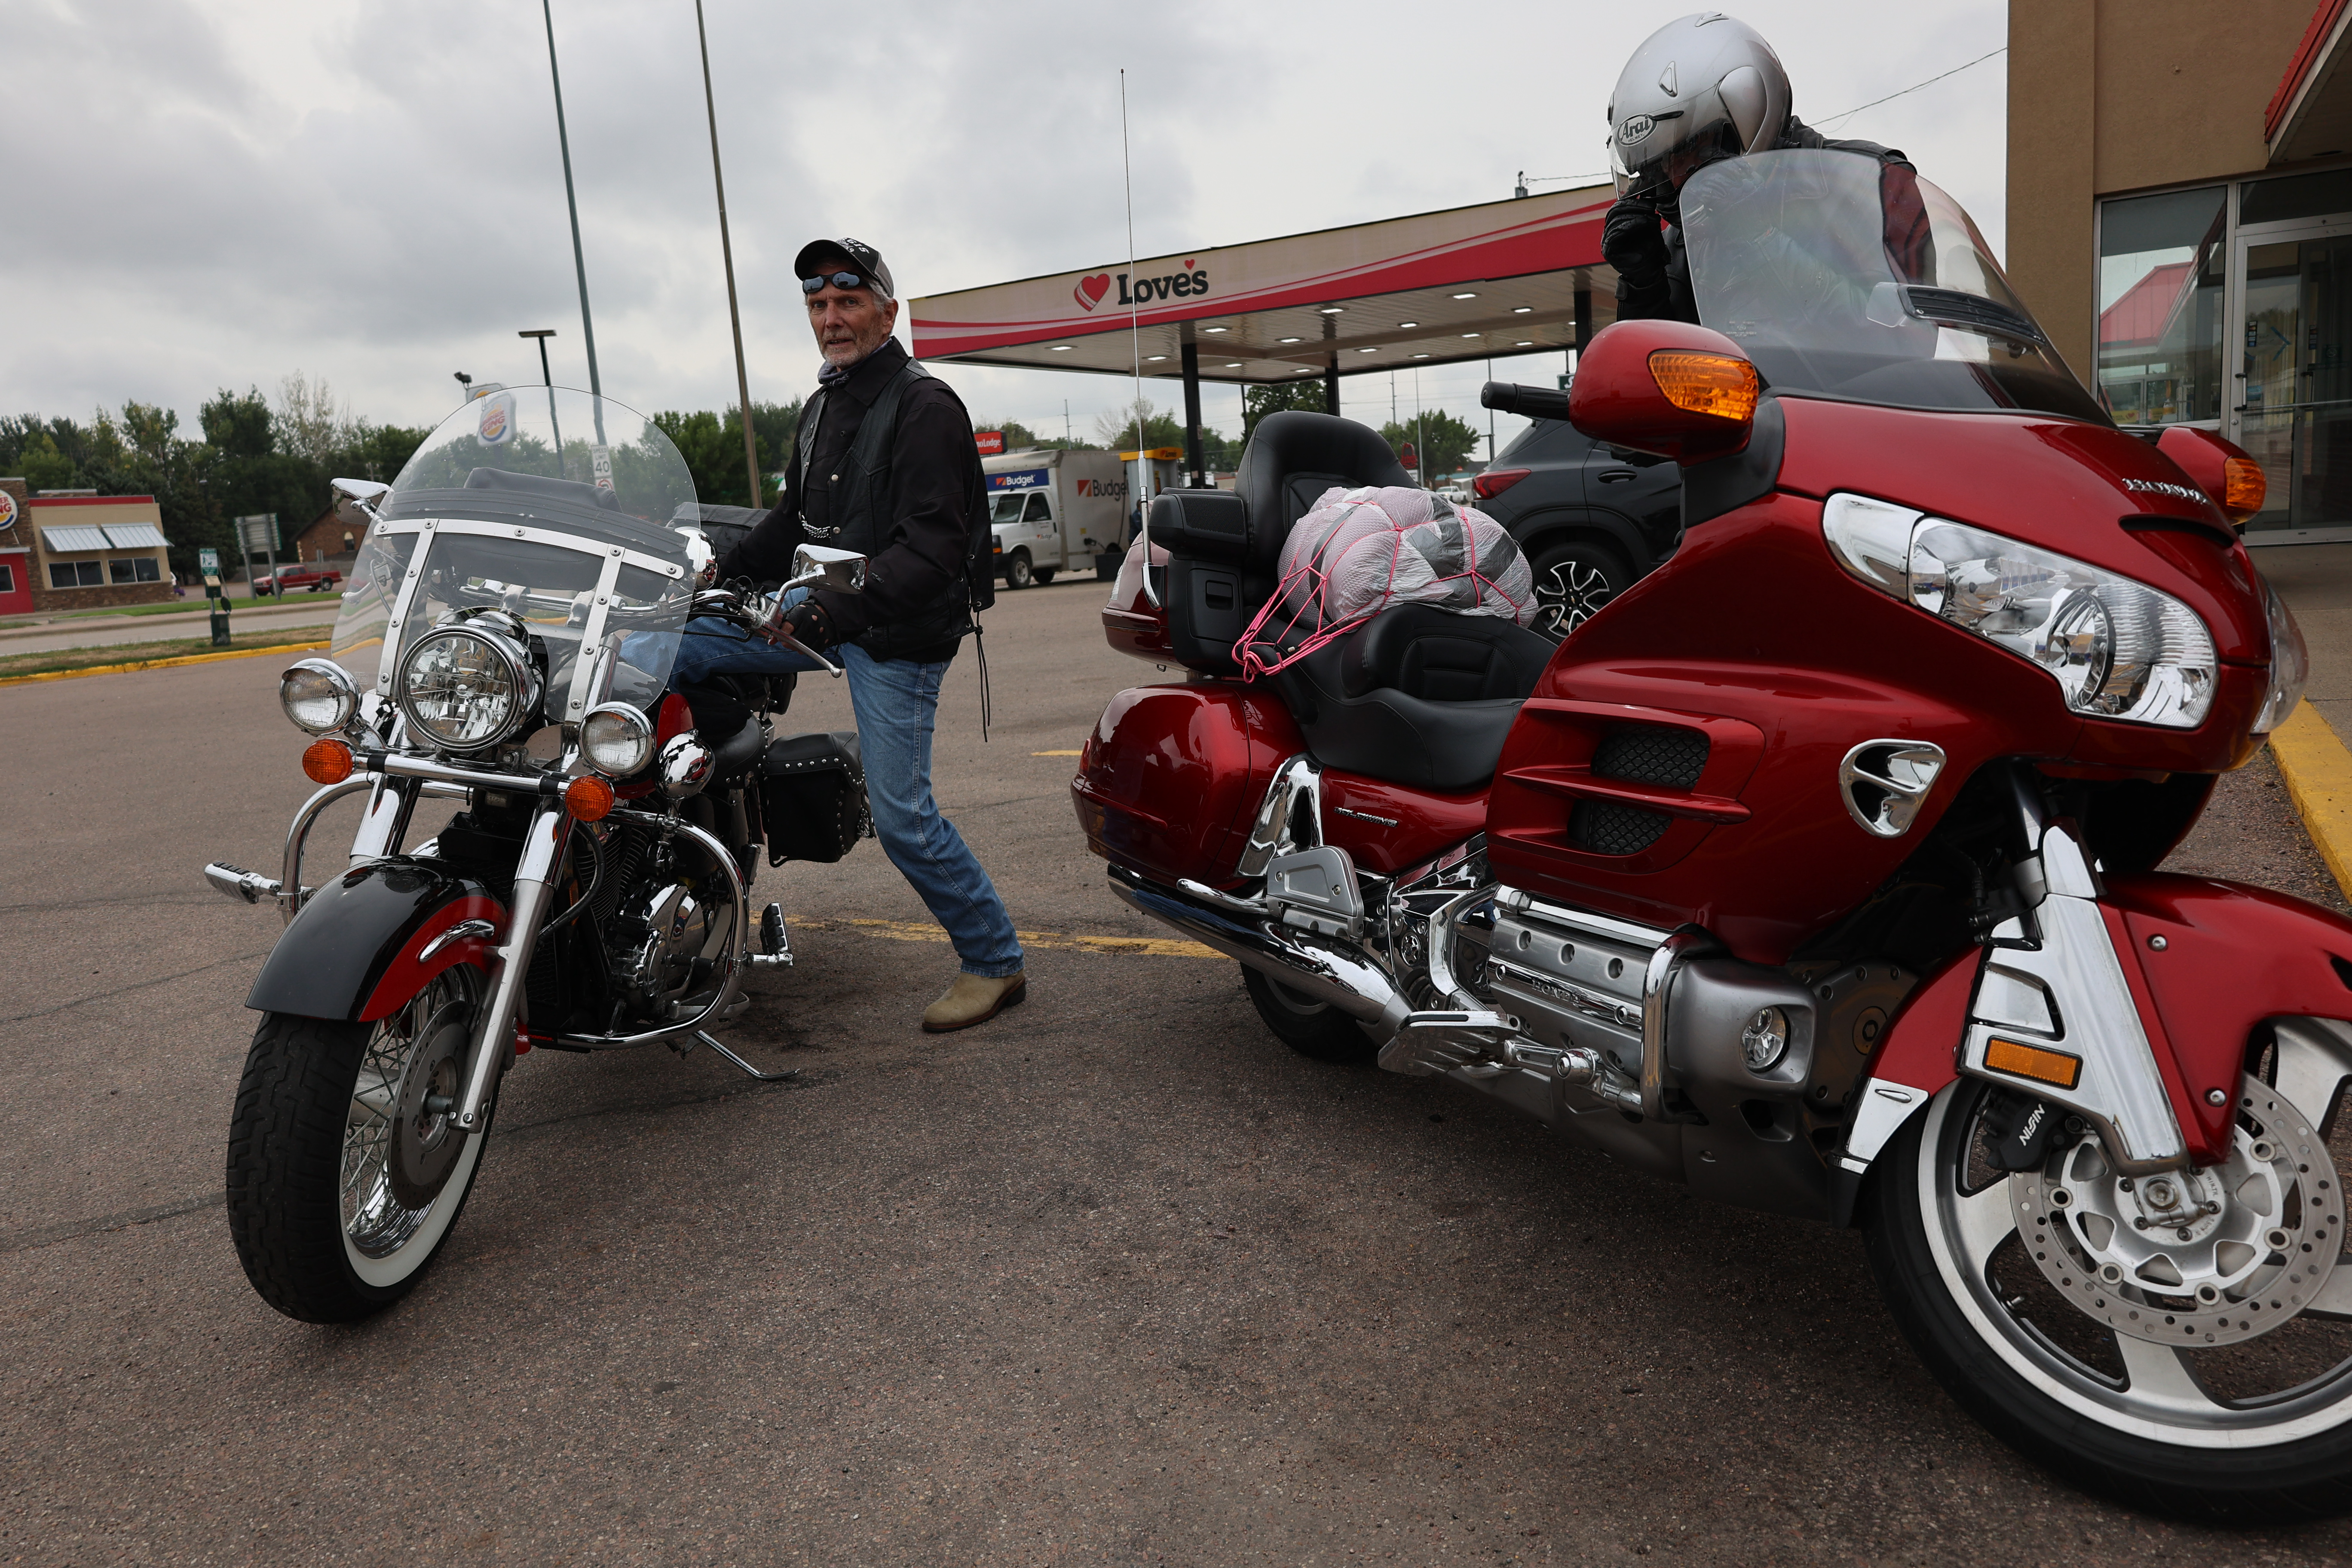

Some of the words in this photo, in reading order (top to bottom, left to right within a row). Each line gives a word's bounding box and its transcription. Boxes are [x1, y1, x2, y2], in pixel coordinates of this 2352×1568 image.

[1620, 115, 1651, 142] Arai
[1628, 133, 1643, 142] HELMET
[481, 416, 505, 435] KING
[595, 461, 609, 472] 40
[1007, 475, 1035, 486] Budget
[2122, 478, 2211, 505] HONDA
[1531, 978, 1580, 1007] HONDA
[2019, 1103, 2045, 1146] NISSIN
